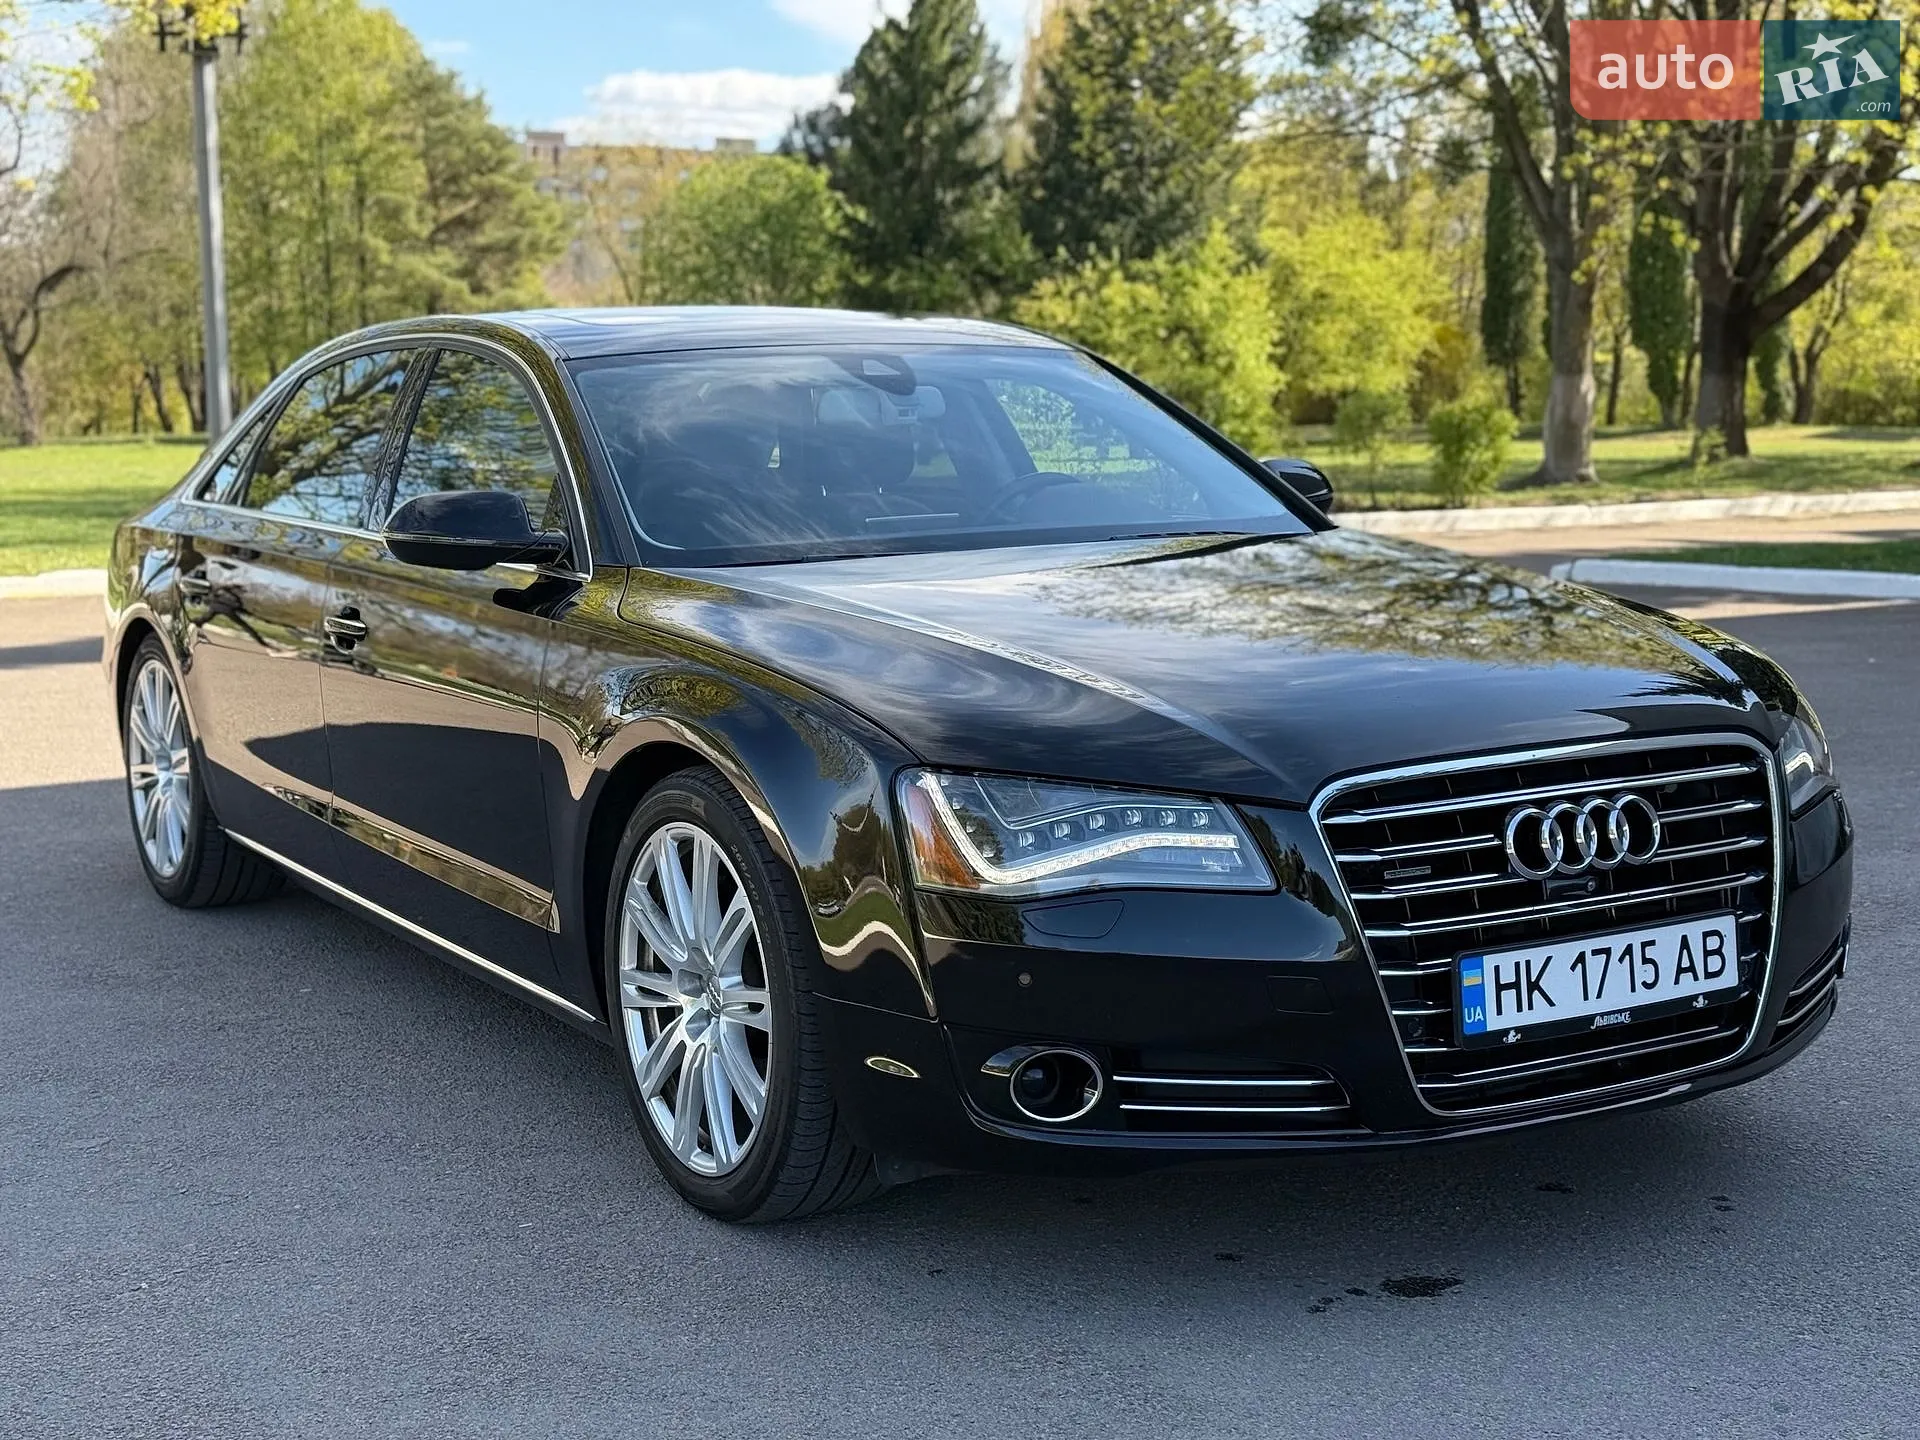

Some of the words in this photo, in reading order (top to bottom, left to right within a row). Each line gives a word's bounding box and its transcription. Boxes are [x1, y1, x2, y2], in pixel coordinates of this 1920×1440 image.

[1494, 955, 1556, 1016] HK
[1569, 939, 1660, 1001] 1715
[1673, 929, 1727, 985] AB
[1465, 1006, 1484, 1023] UA
